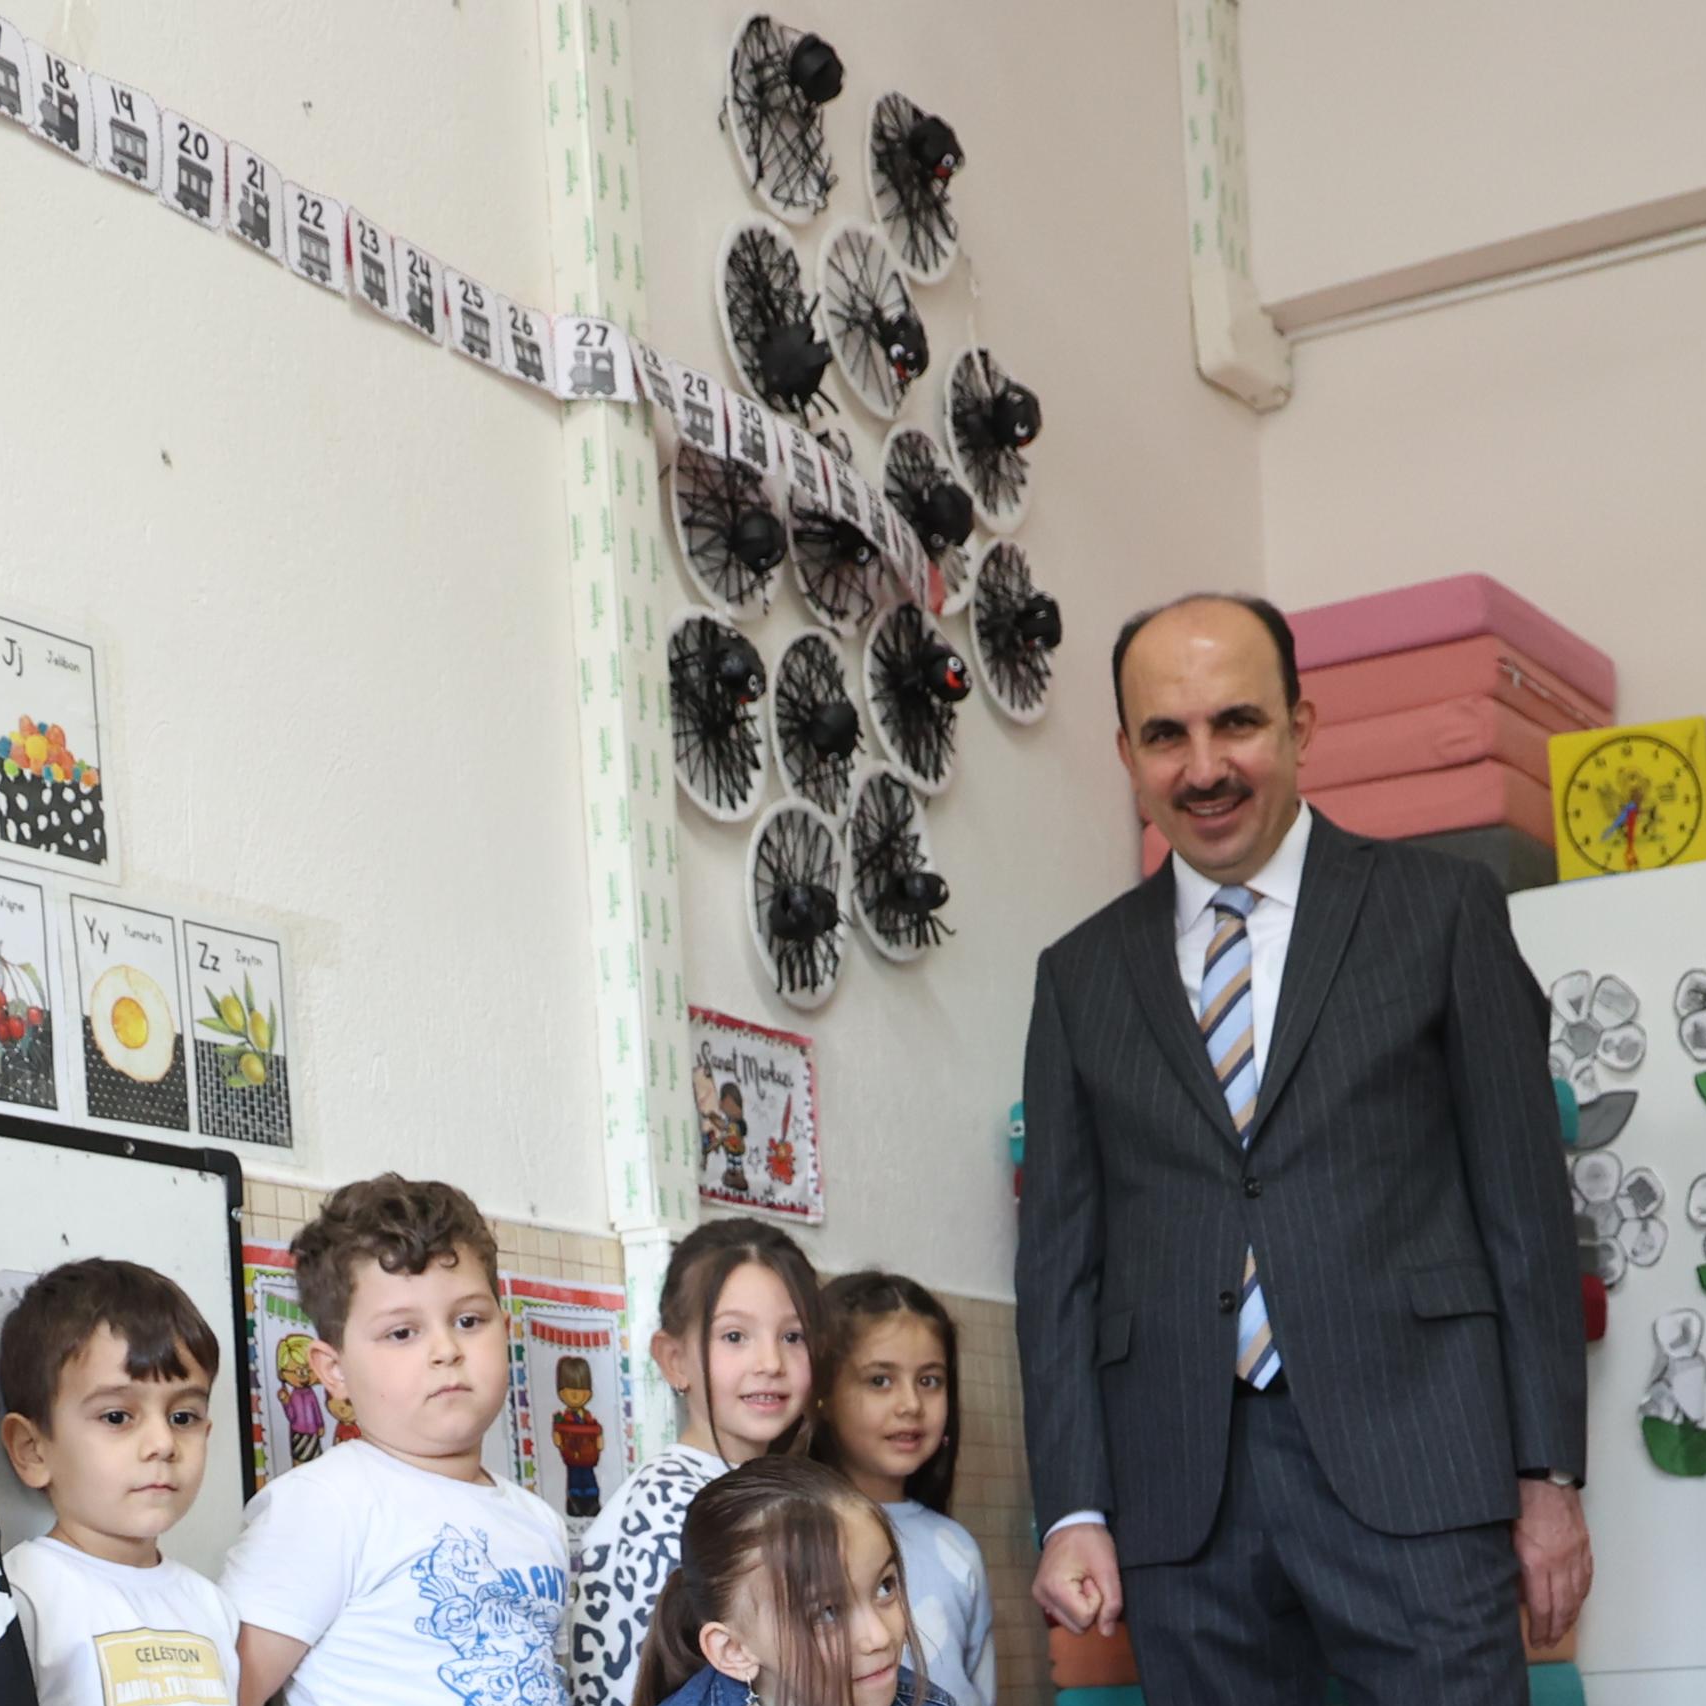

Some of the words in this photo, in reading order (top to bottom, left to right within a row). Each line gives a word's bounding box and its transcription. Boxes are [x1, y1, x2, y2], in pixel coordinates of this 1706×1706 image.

[45, 53, 70, 90] 18
[110, 85, 136, 122] 19
[178, 122, 209, 161] 20
[246, 156, 266, 192] 21
[296, 192, 326, 230] 22
[357, 220, 380, 255] 23
[406, 249, 432, 279] 24
[458, 278, 486, 310] 25
[507, 306, 533, 337] 26
[575, 322, 609, 349] 27
[683, 371, 709, 402] 29
[2, 637, 24, 677] Jj
[84, 915, 110, 954] Yy
[196, 940, 222, 973] Zz
[135, 1646, 201, 1663] CELESTON
